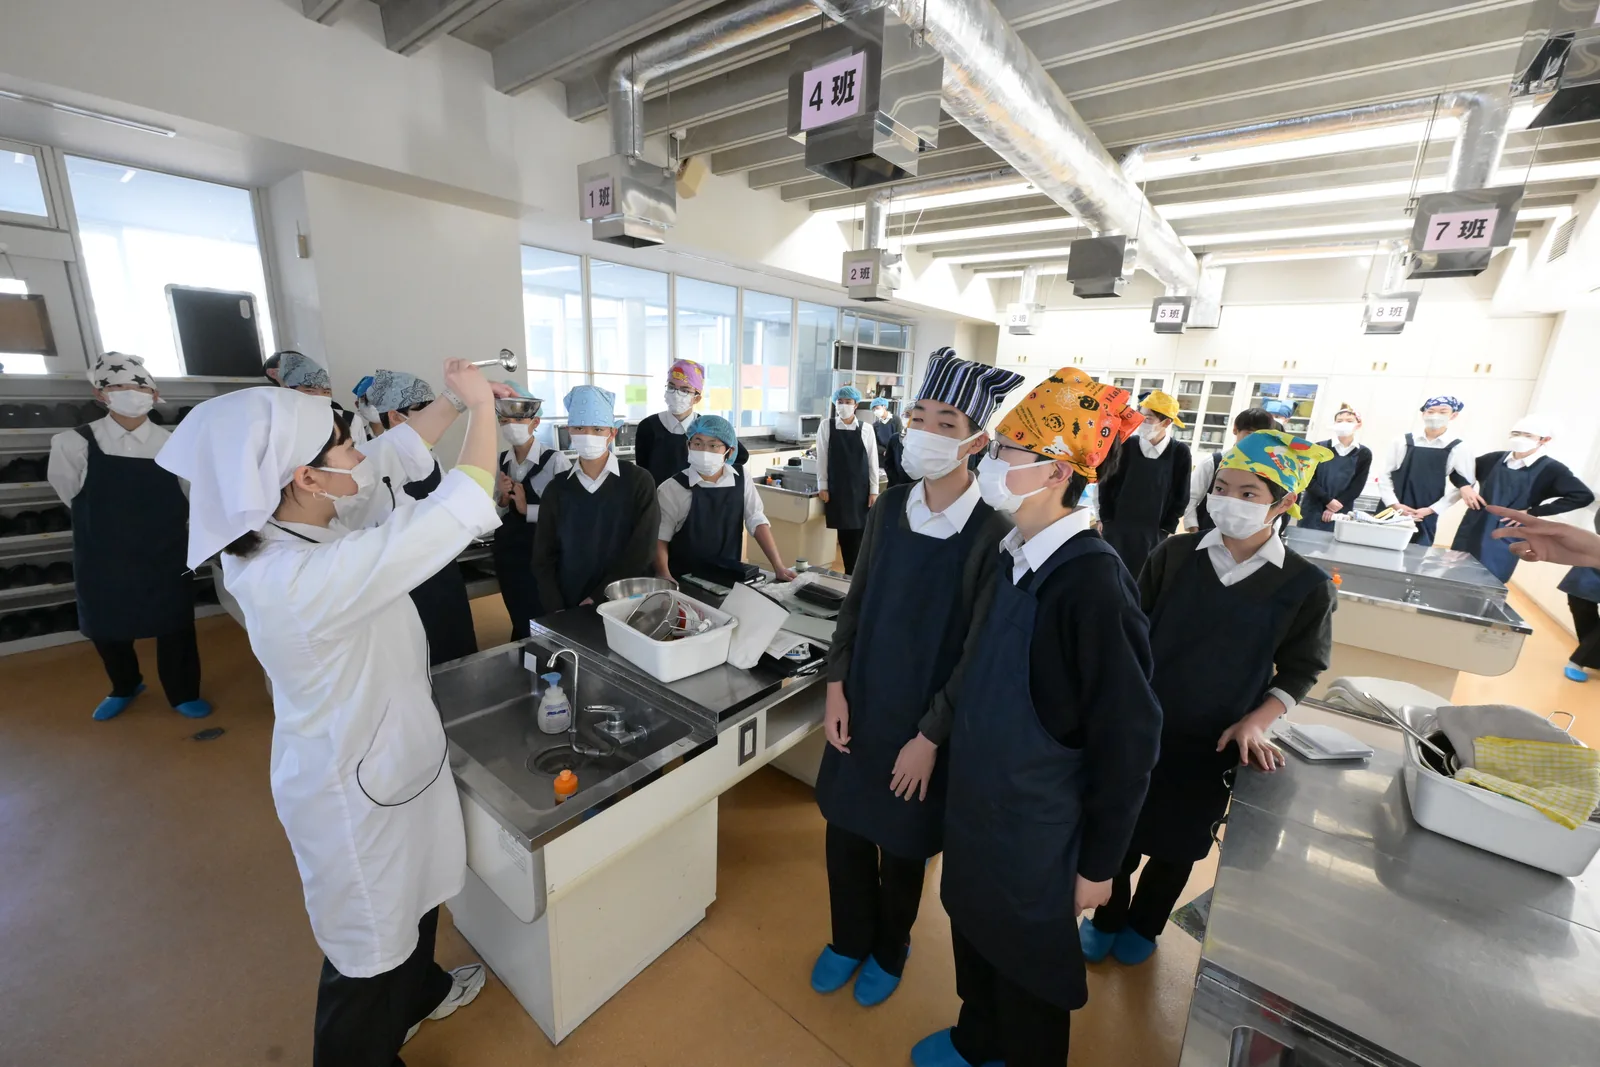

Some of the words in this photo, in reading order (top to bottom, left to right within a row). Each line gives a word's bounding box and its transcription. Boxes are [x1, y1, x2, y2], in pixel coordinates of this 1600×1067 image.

[809, 68, 857, 112] 4班
[588, 186, 610, 209] 1班
[1435, 218, 1489, 241] 7班
[850, 266, 871, 280] 2班
[1160, 309, 1180, 319] 5班
